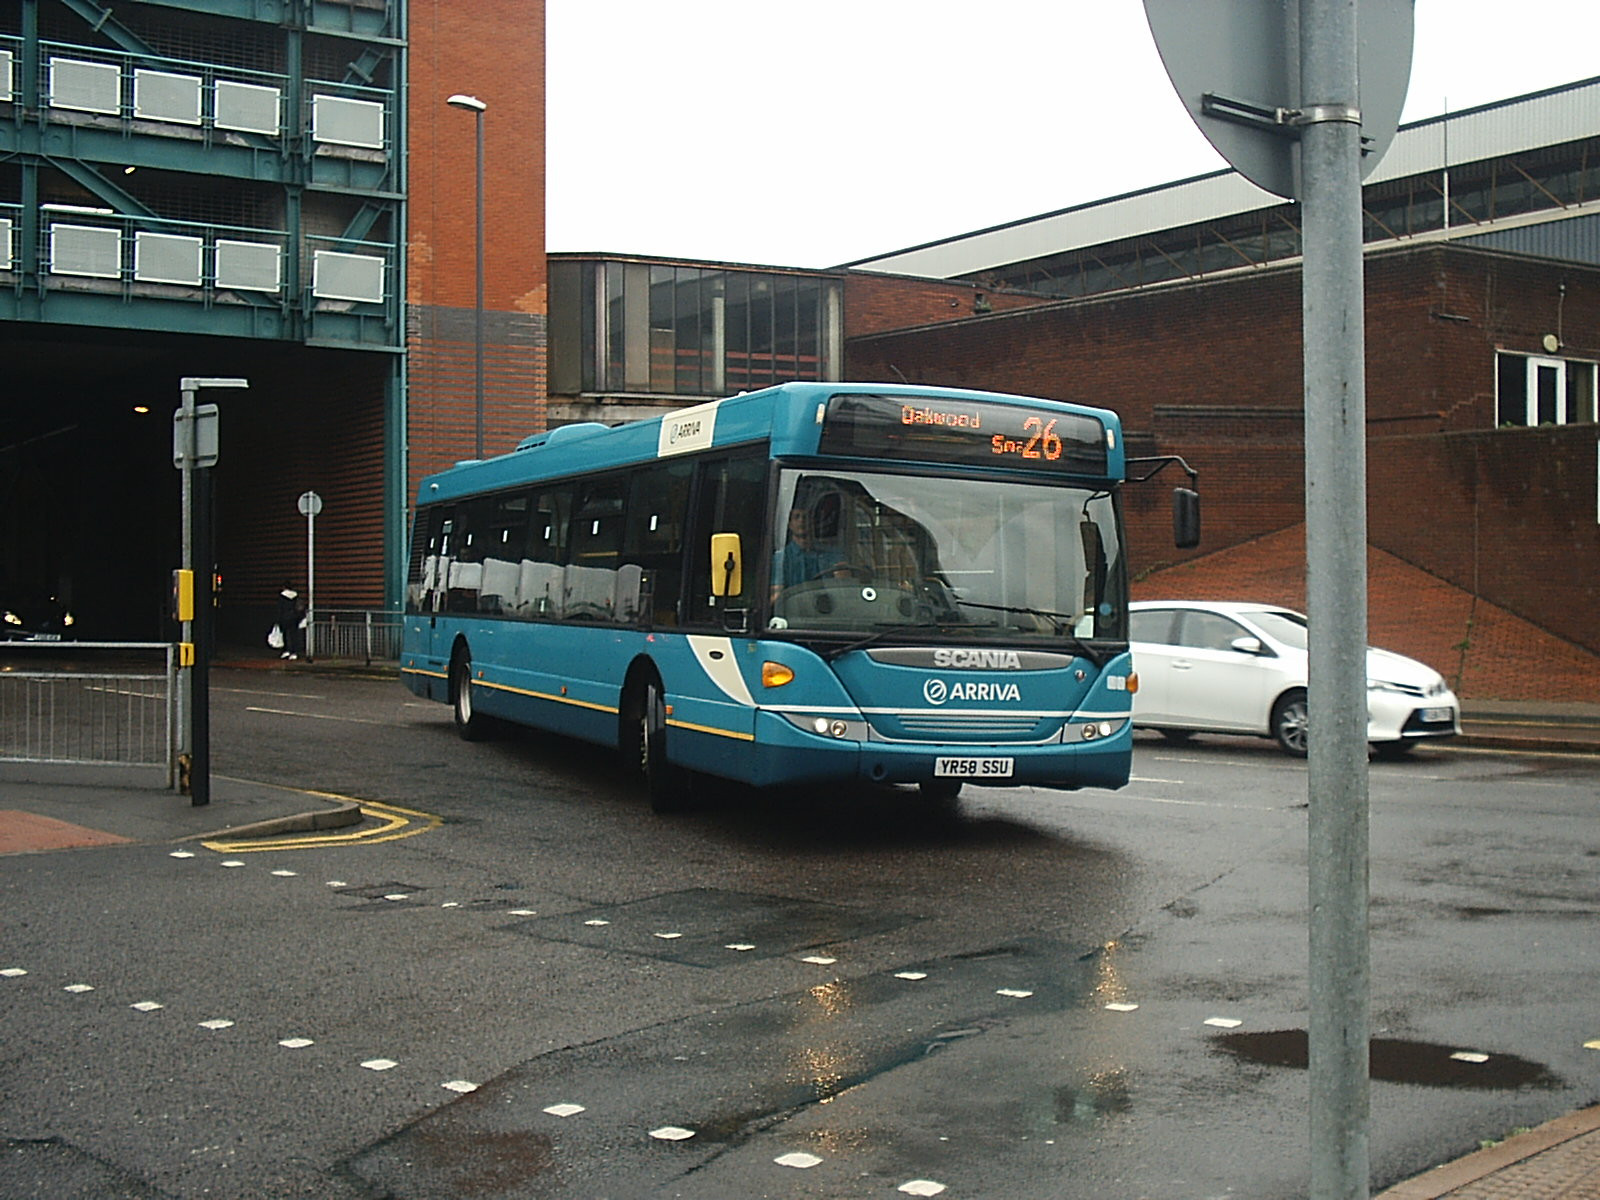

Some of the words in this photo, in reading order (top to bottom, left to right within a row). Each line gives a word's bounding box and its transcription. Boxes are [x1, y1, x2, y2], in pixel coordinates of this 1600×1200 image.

[901, 405, 981, 428] Oakwood
[678, 421, 701, 438] ARRIVA
[1021, 416, 1063, 460] 26
[934, 650, 1021, 668] SCANIA
[949, 683, 1021, 700] ARRIVA
[941, 759, 977, 774] YR58
[982, 760, 1009, 775] SSU
